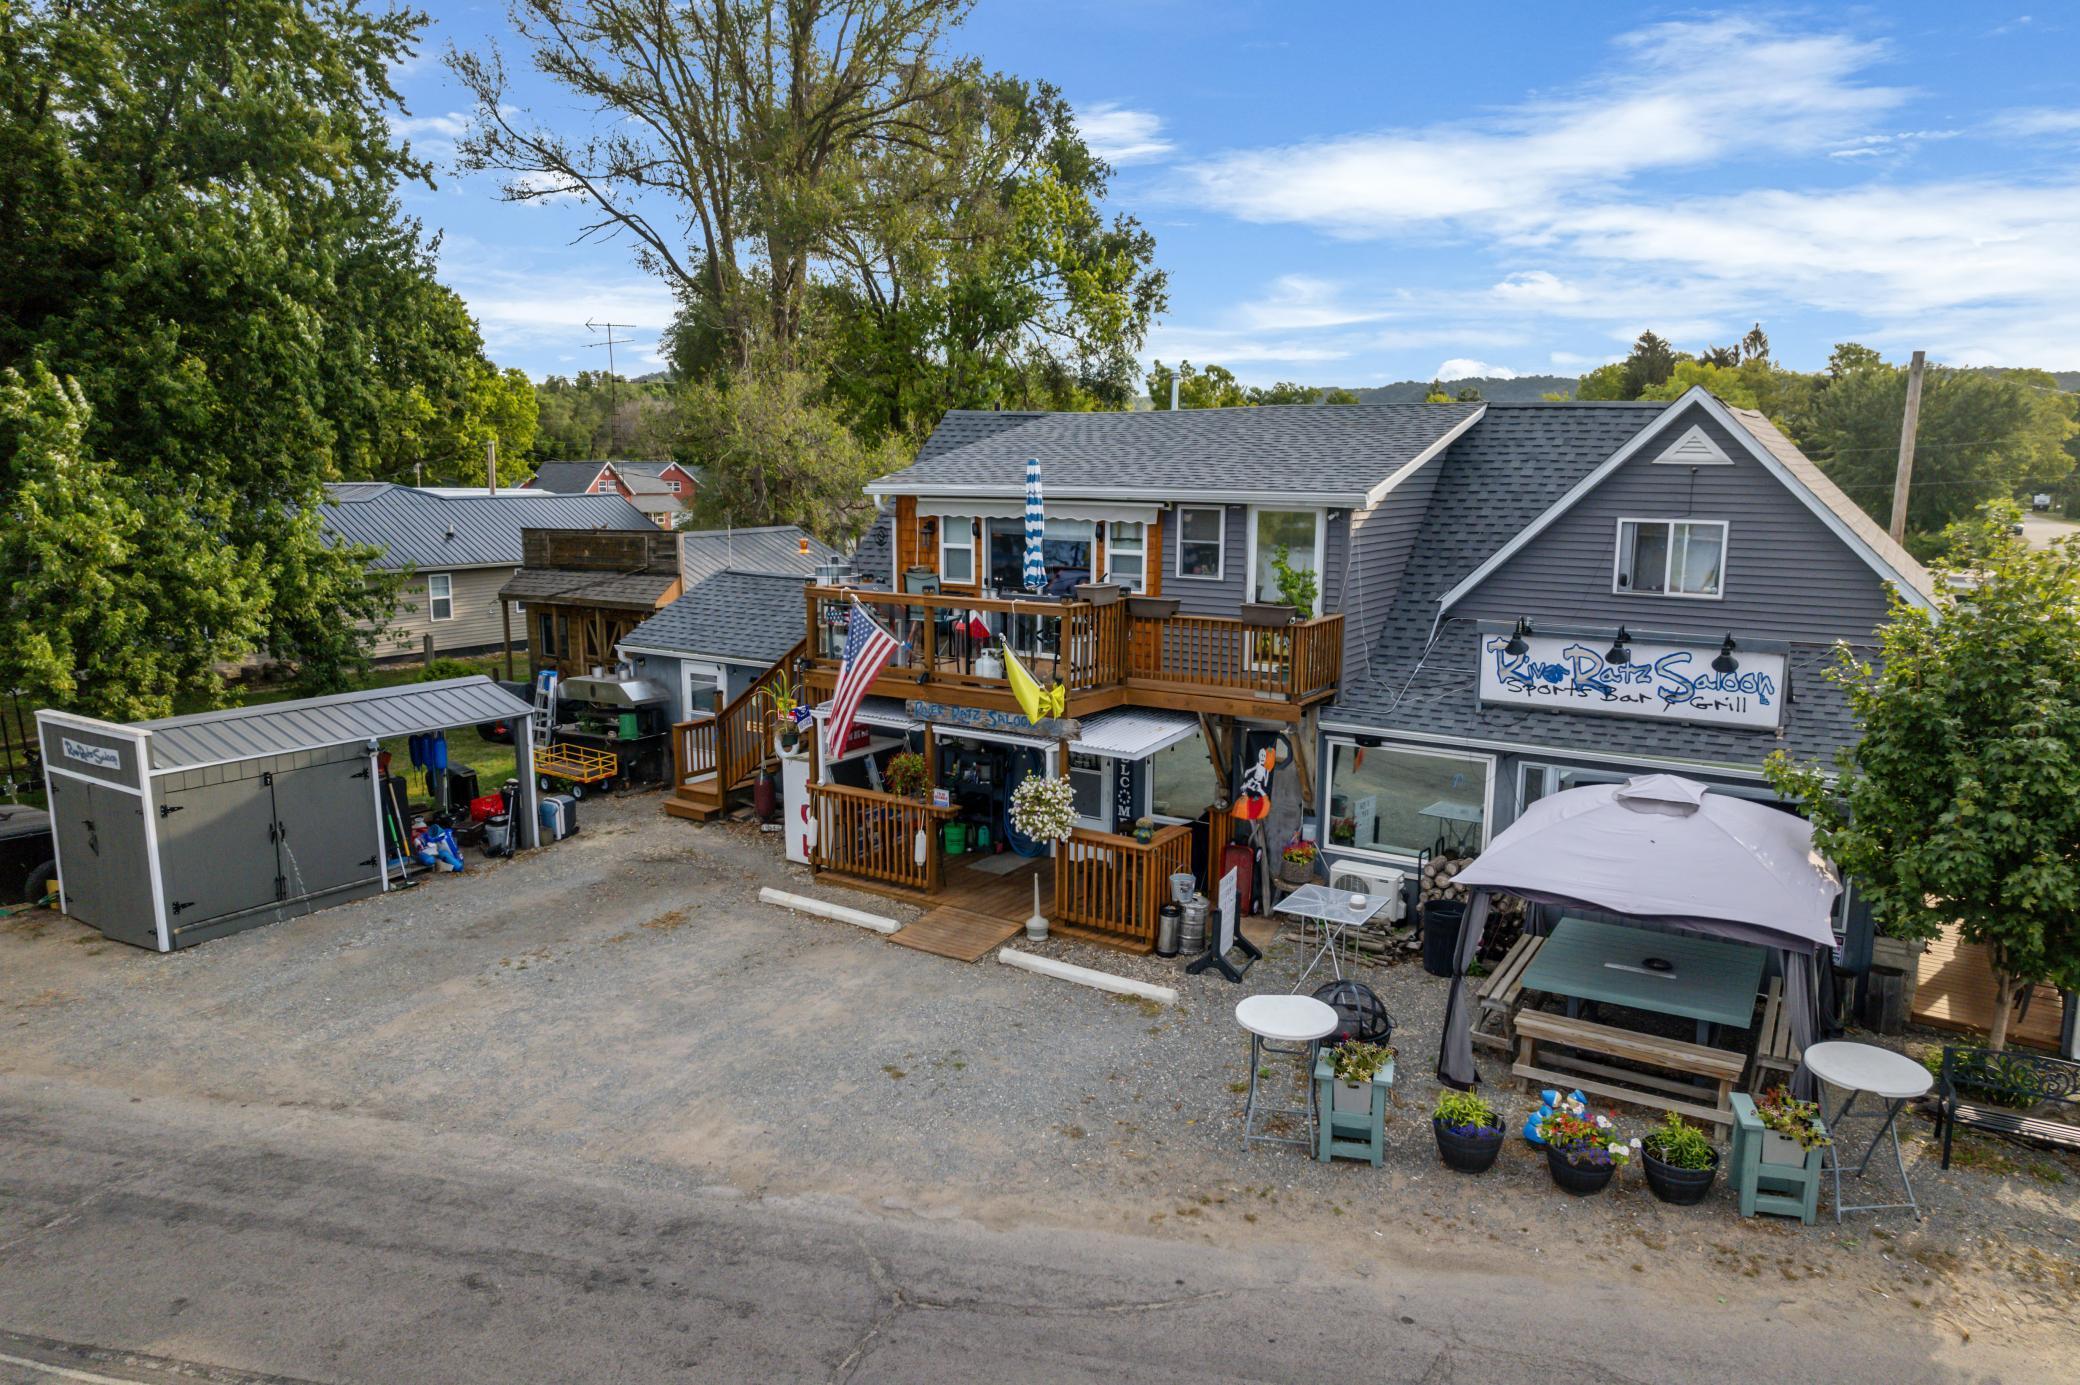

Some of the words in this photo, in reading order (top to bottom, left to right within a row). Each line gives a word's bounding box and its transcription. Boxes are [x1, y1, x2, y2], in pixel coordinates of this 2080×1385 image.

[1506, 678, 1593, 698] Sports
[1599, 684, 1653, 704] Bar
[1689, 695, 1747, 714] Grill
[1562, 643, 1653, 697] Ratz
[1654, 651, 1775, 705] Saloon
